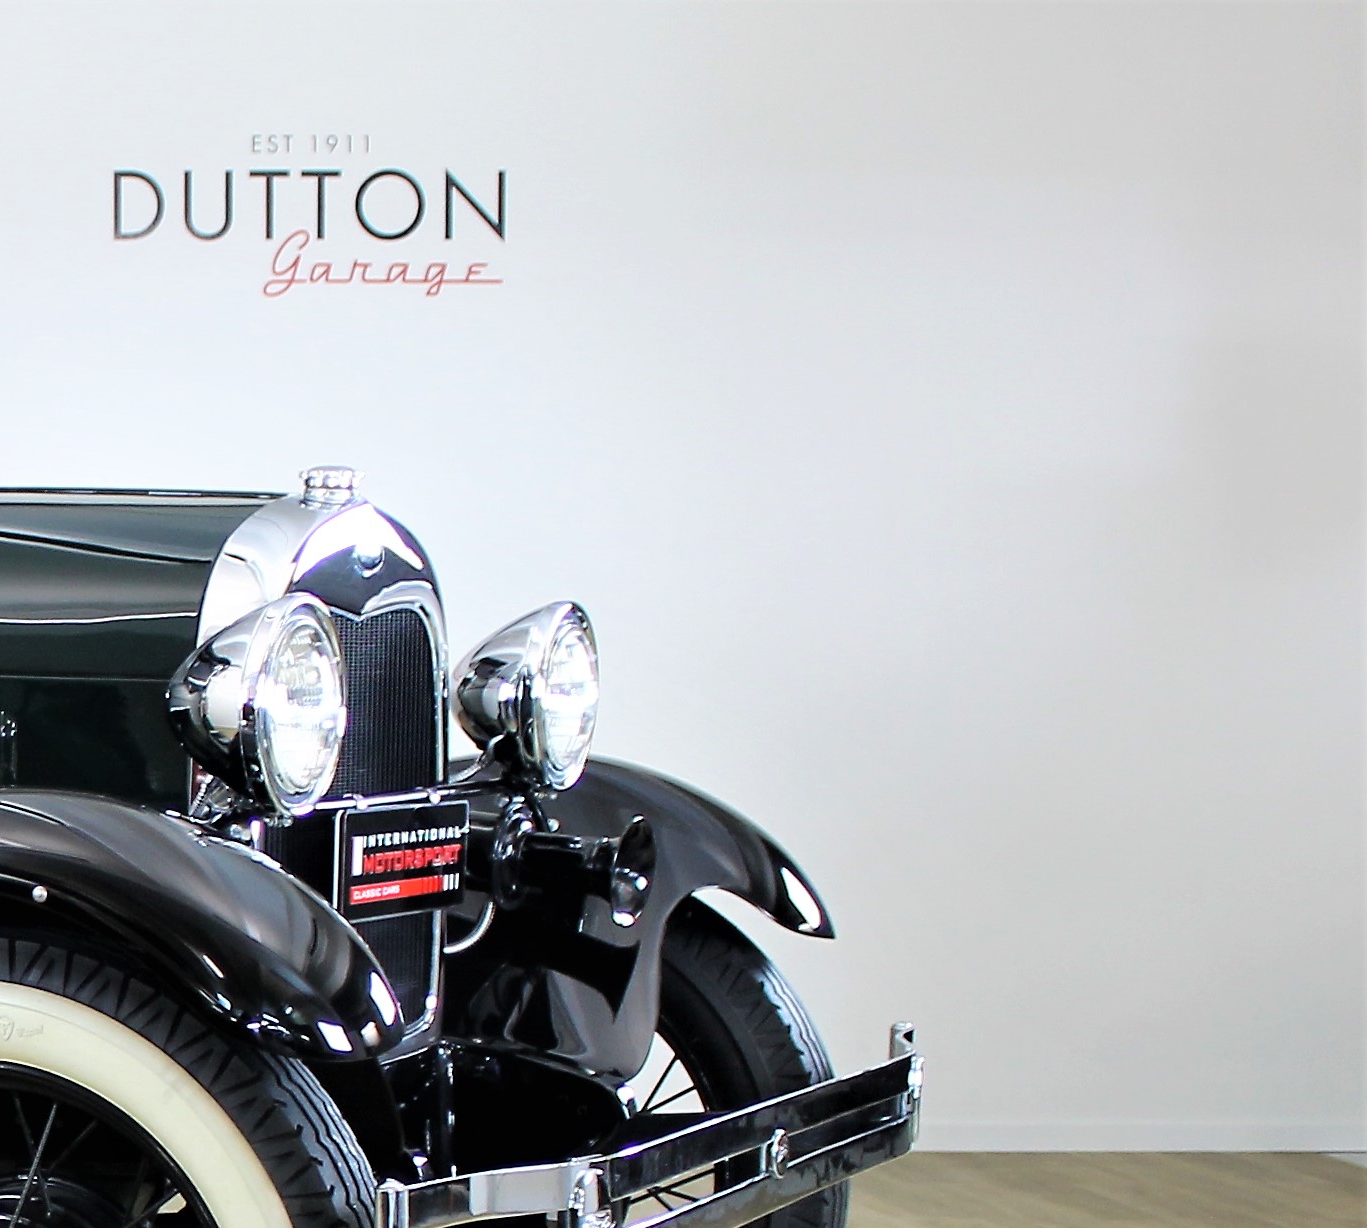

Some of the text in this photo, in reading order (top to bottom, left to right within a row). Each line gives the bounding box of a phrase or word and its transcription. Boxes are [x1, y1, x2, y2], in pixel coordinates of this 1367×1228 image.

[251, 134, 371, 153] EST 1911
[113, 168, 507, 241] DUTTON
[263, 229, 504, 297] Garage
[363, 825, 462, 849] INTERNATIONAL
[362, 843, 462, 876] MOTORSPORT
[353, 886, 382, 900] CLASSIC
